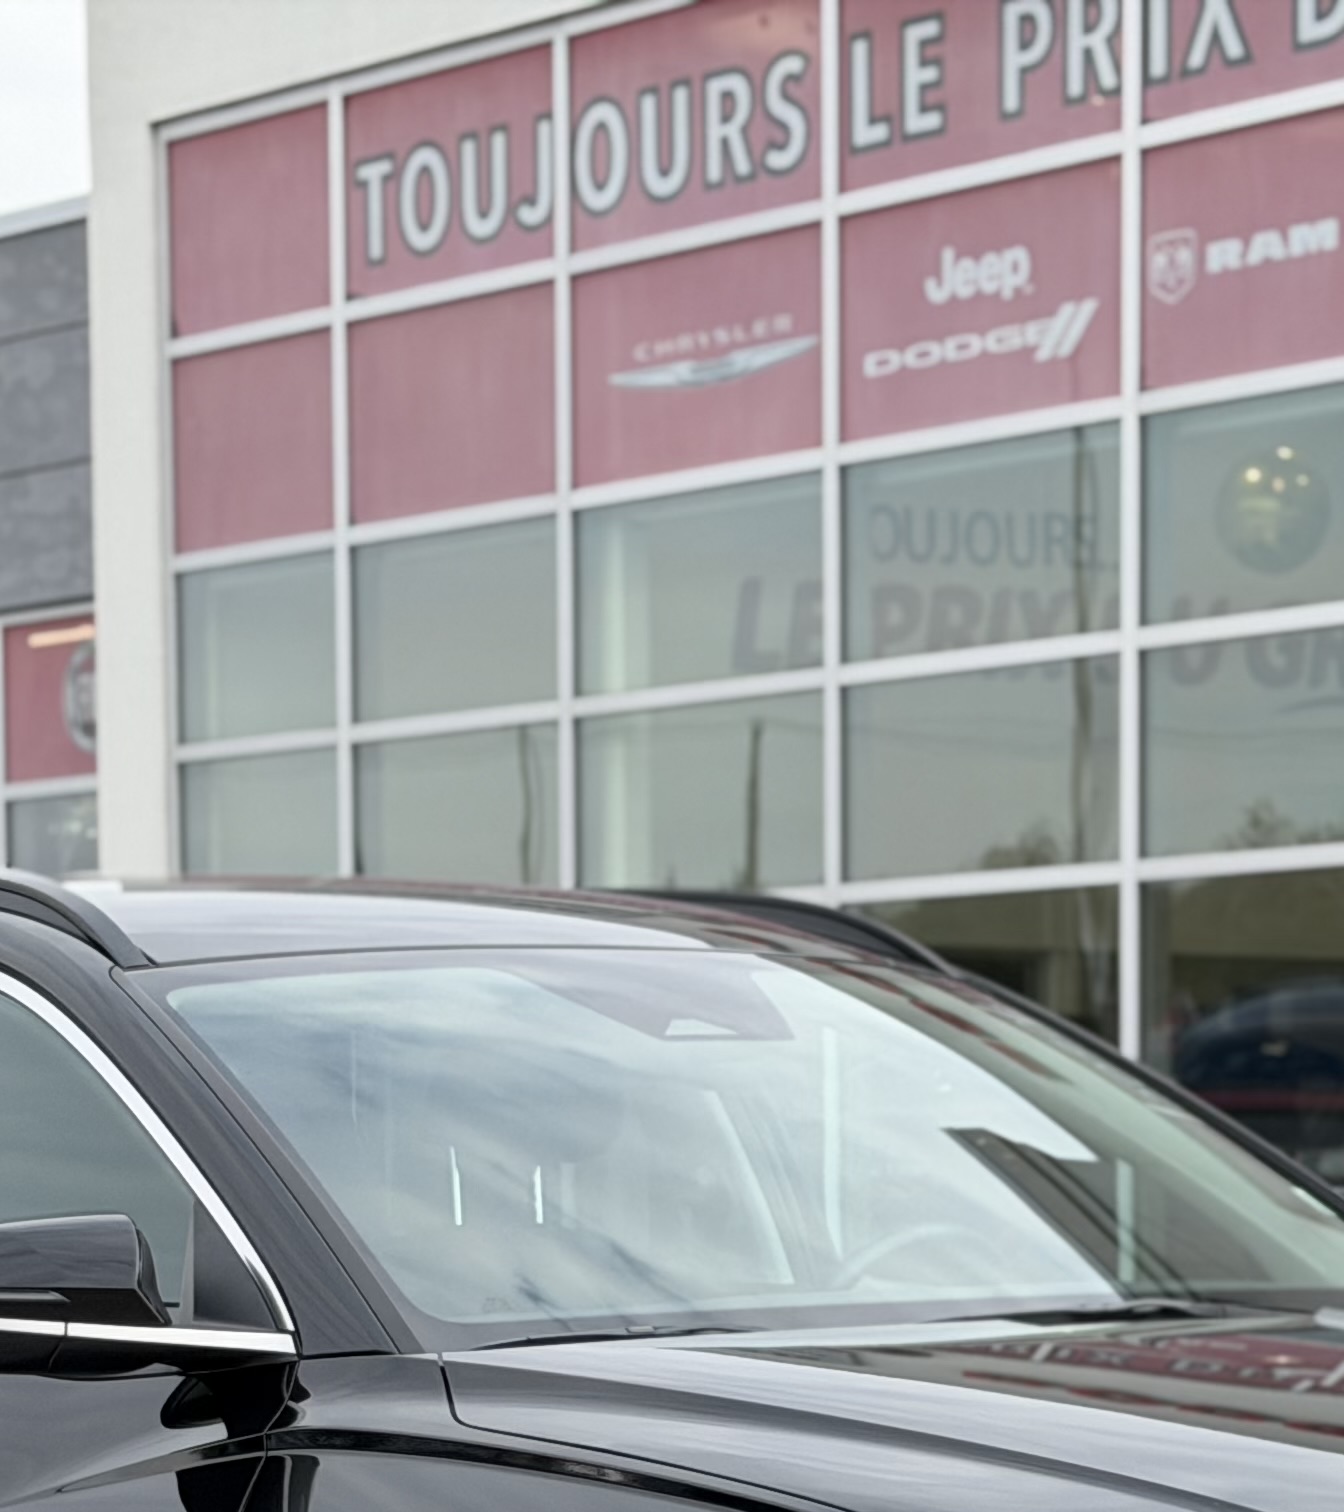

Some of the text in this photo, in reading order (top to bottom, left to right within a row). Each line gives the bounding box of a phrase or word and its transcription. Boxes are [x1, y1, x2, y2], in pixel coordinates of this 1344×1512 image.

[353, 48, 811, 267] TOUJOURS
[850, 17, 946, 153] LE
[923, 245, 1032, 305] Jeep
[1205, 217, 1341, 276] RAM
[862, 315, 1058, 380] DODGE
